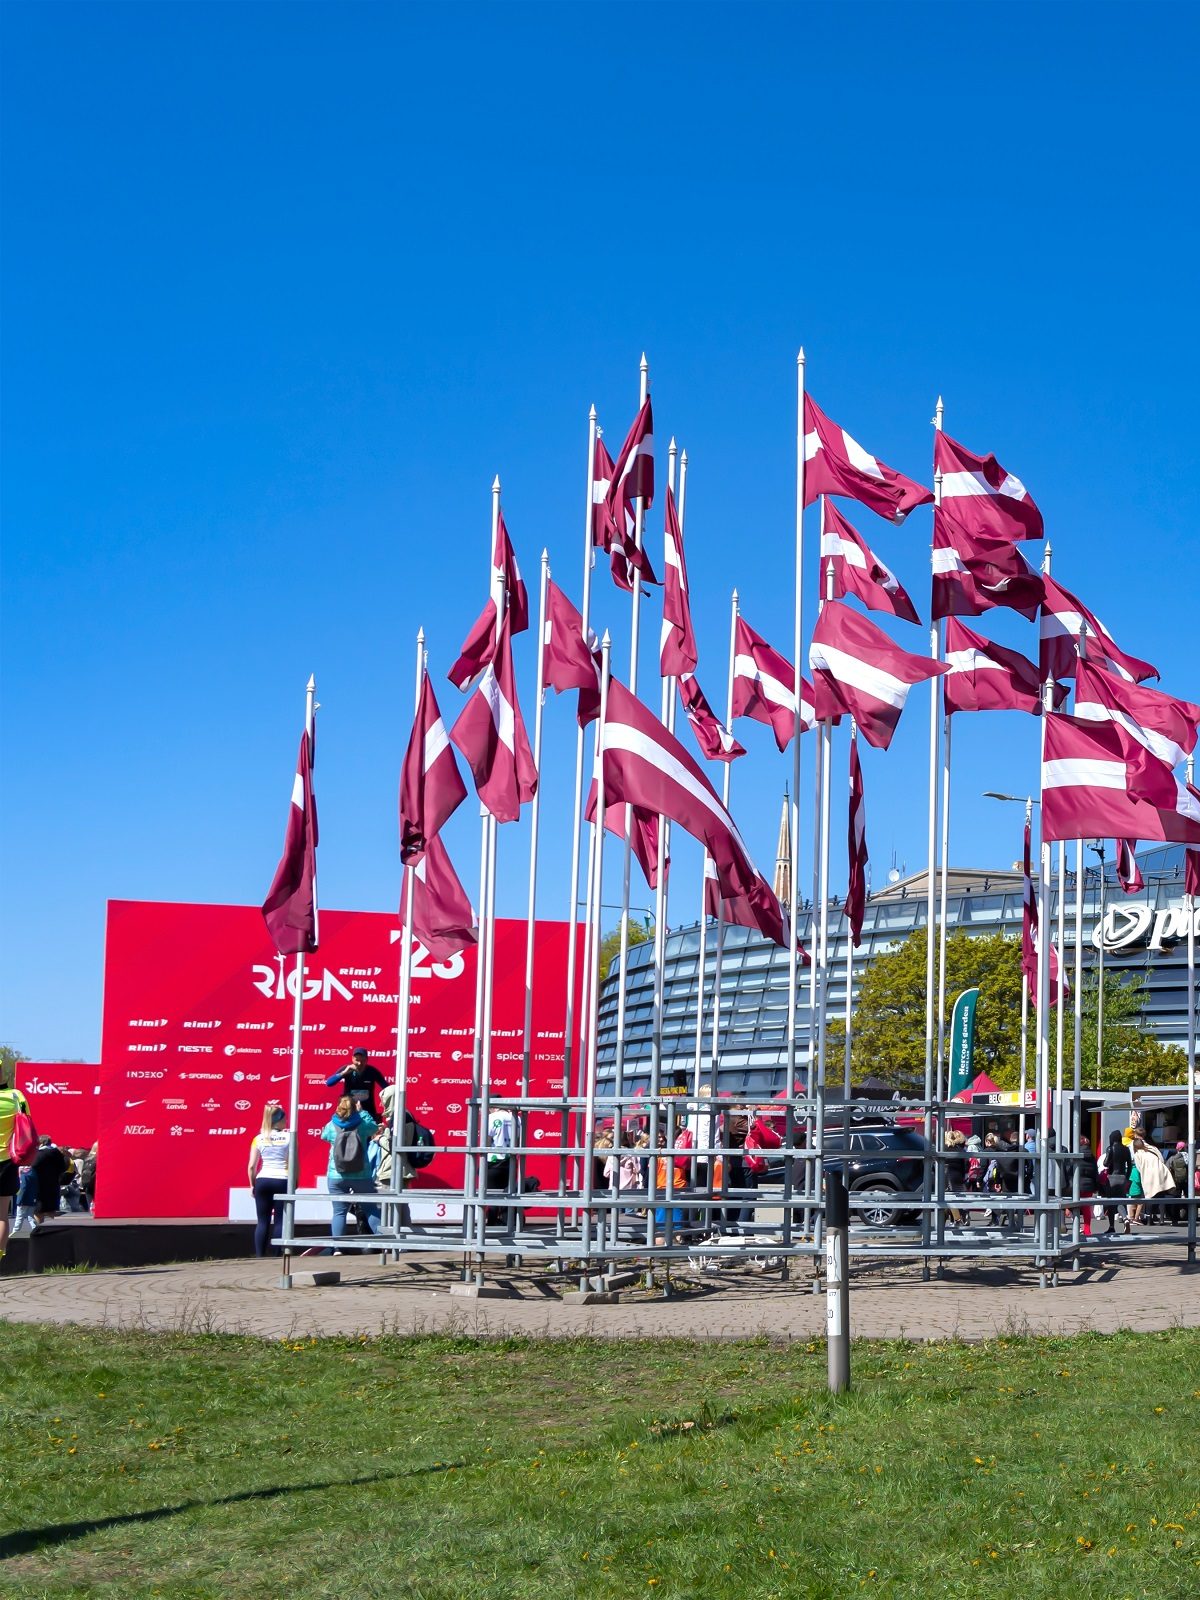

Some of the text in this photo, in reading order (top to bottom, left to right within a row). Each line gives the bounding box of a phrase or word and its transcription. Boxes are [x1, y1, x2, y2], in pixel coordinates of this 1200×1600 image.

[351, 979, 377, 990] RIGA
[362, 993, 421, 1004] MARATON
[314, 1048, 349, 1056] INDEXO
[496, 1052, 525, 1061] spice
[958, 1039, 968, 1075] Hercogs
[126, 1071, 164, 1079] INDEXO
[246, 1073, 261, 1081] dpd
[448, 1129, 469, 1137] NES
[436, 1203, 446, 1217] 3
